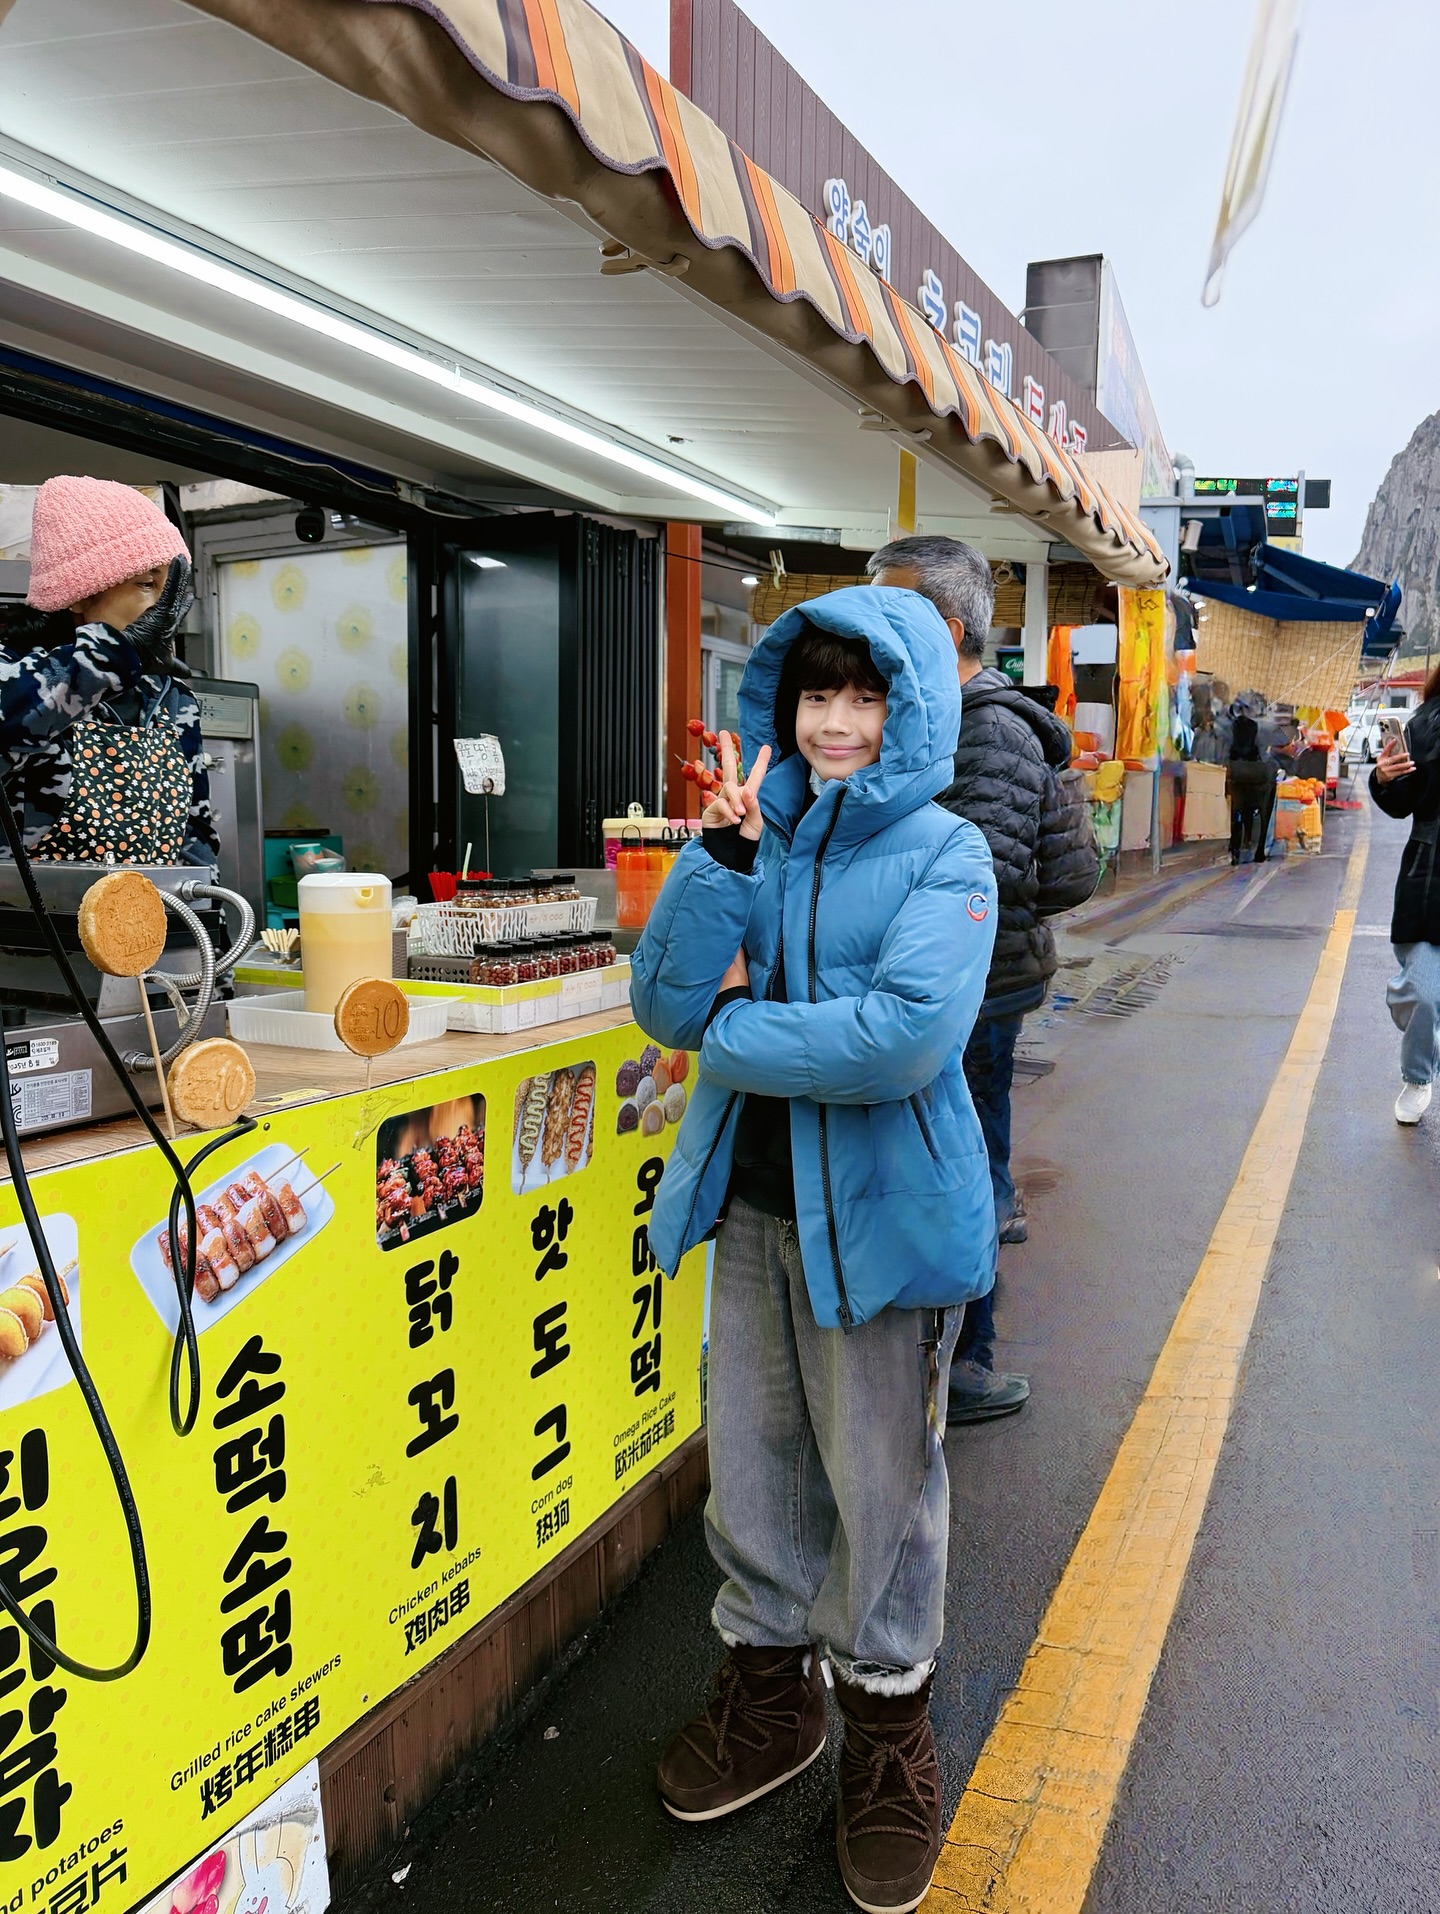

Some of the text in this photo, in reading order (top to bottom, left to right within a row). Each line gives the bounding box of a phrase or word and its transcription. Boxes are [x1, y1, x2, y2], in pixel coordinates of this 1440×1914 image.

[531, 1197, 574, 1482] 핫도그
[405, 1249, 460, 1570] 닭꼬치
[613, 1391, 676, 1447] Omega Rice Cake
[615, 1407, 675, 1481] 欧米茄年糕
[213, 1334, 293, 1695] 소떡소떡
[531, 1474, 573, 1514] Corn dog
[536, 1497, 570, 1549] 热狗
[388, 1547, 482, 1625] Chicken kebabs
[403, 1577, 470, 1657] 鸡肉串
[170, 1654, 341, 1792] Grilled rice cake skewers
[199, 1695, 321, 1821] 烤年糕串
[31, 1818, 124, 1903] potatoes
